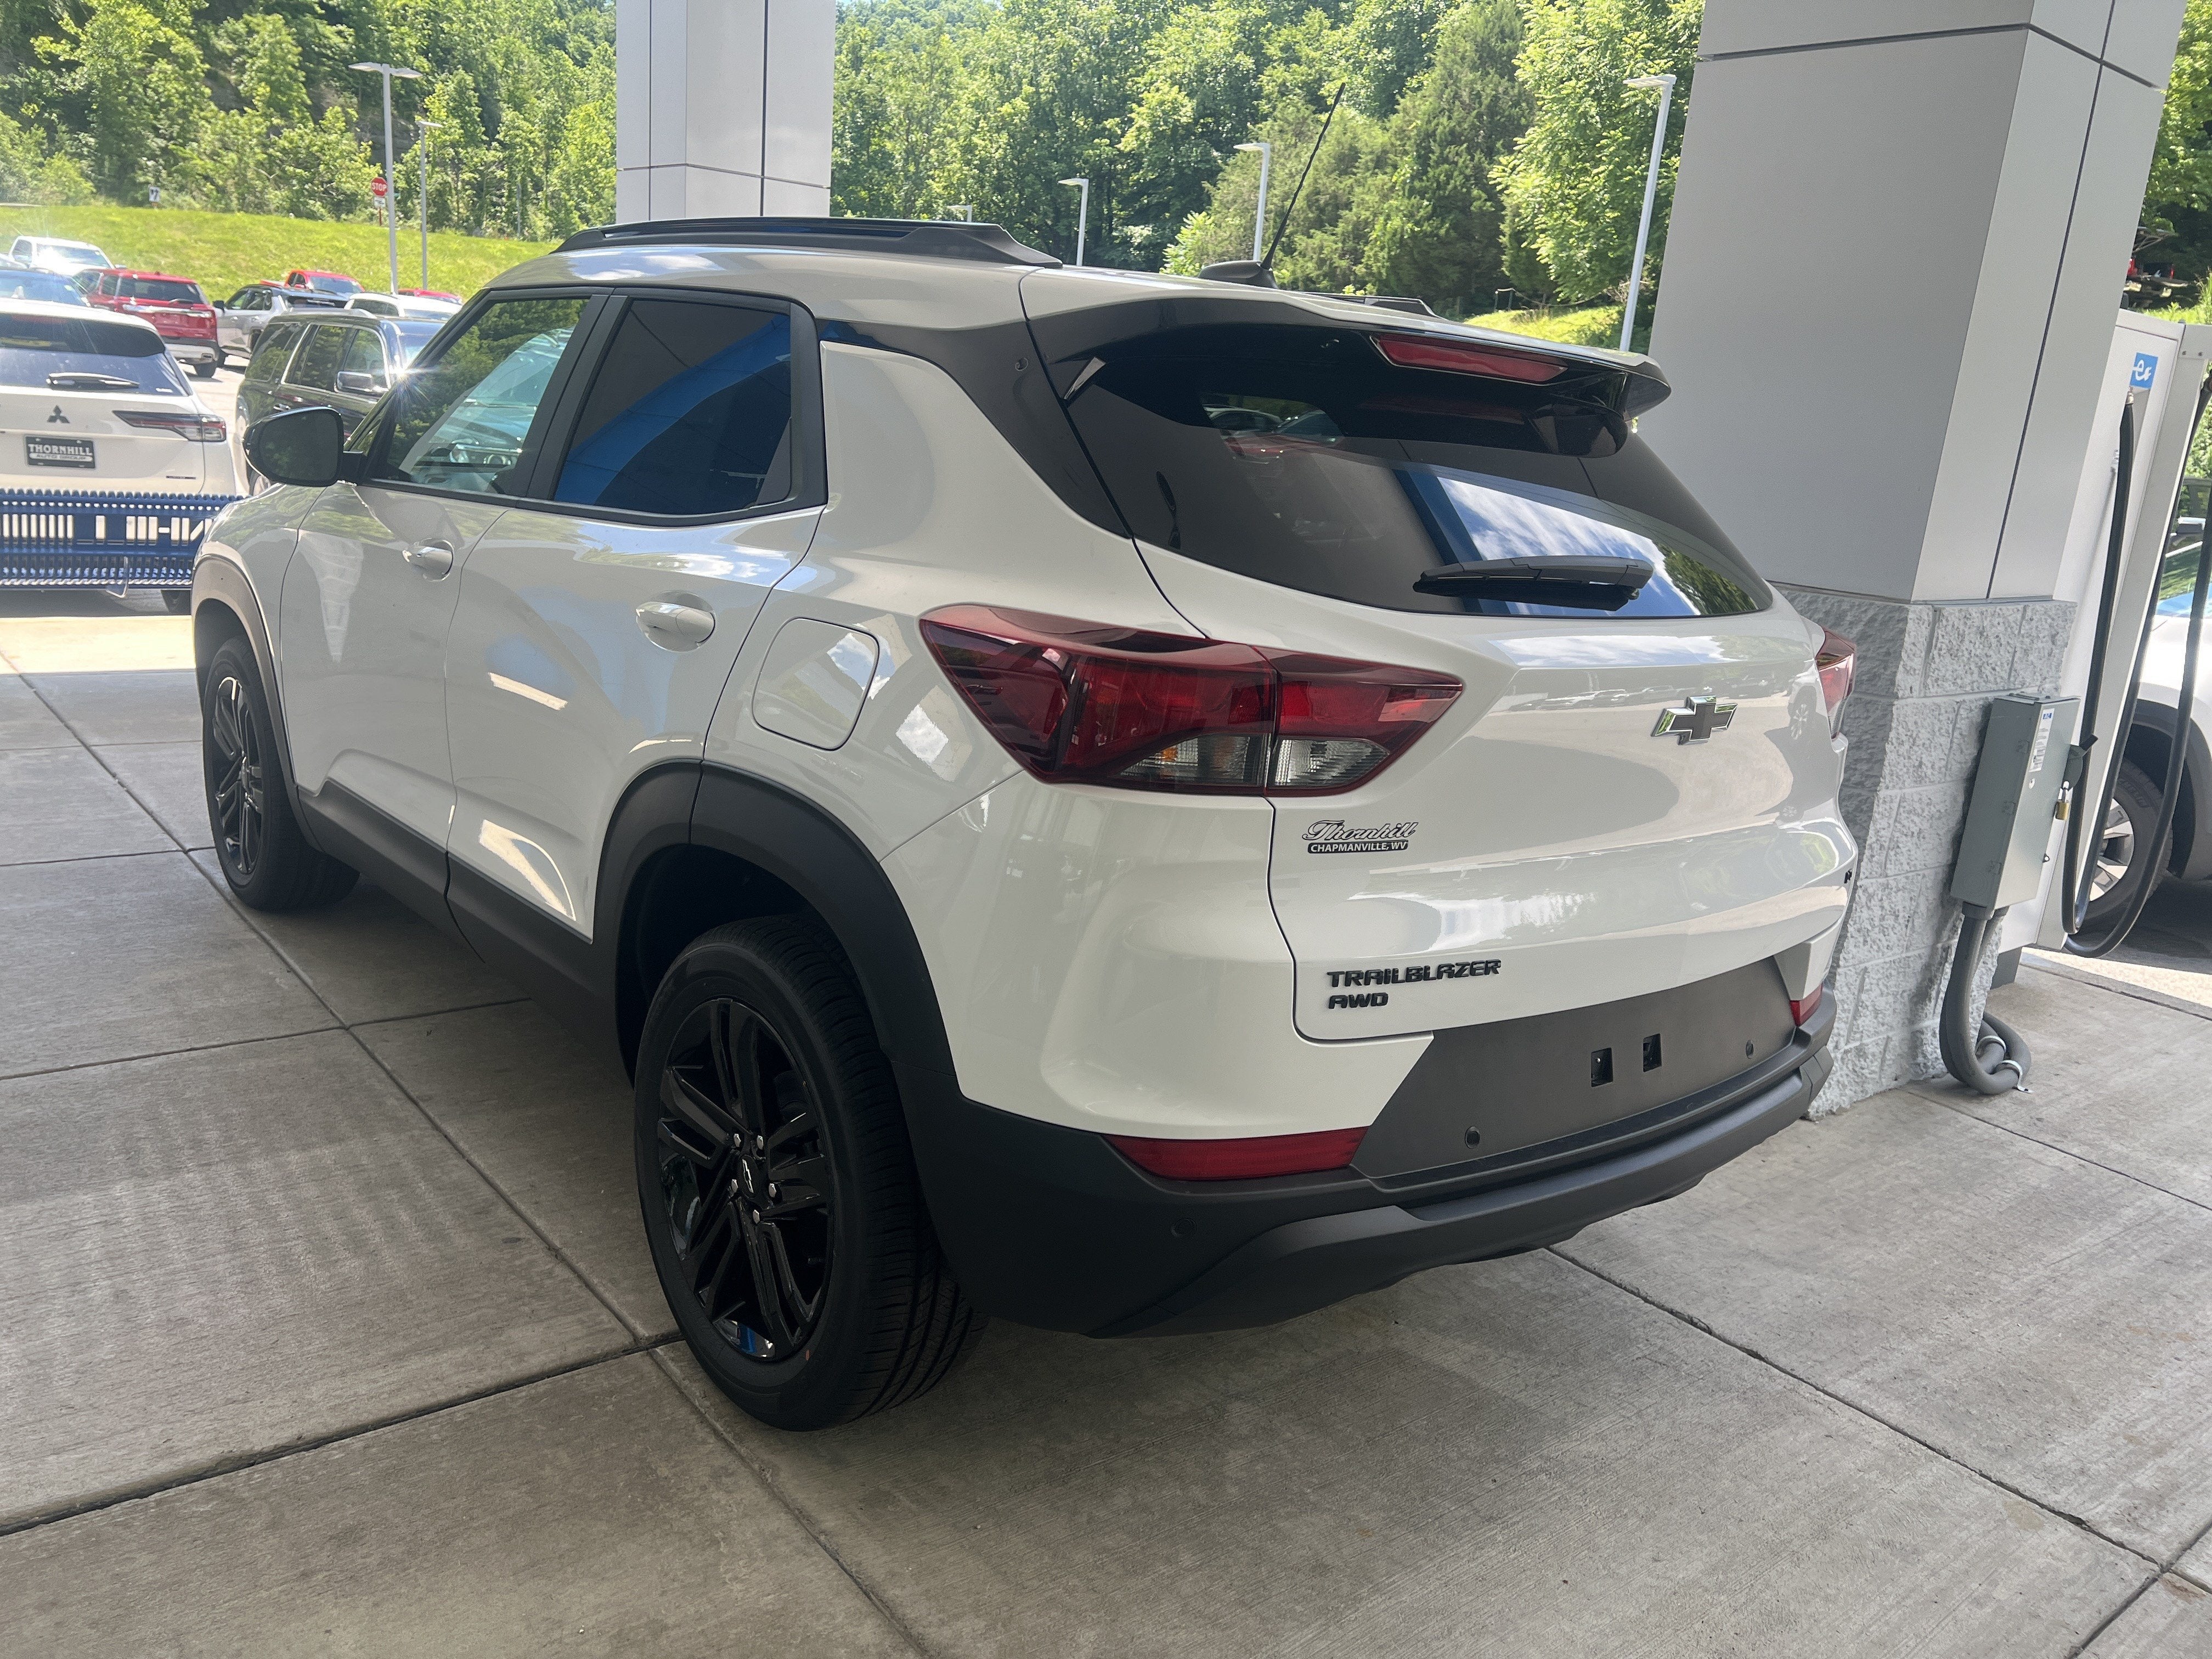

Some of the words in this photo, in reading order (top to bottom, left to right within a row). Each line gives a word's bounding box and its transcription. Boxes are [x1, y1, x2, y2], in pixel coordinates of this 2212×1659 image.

[371, 182, 386, 191] STOP
[28, 443, 93, 456] THORNHILL
[1302, 820, 1419, 840] Thornhill
[1311, 843, 1389, 852] CHAPMANVILLE,
[1391, 841, 1408, 850] WV
[1327, 959, 1502, 988] TRAILBLAZER
[1328, 992, 1389, 1009] AWD
